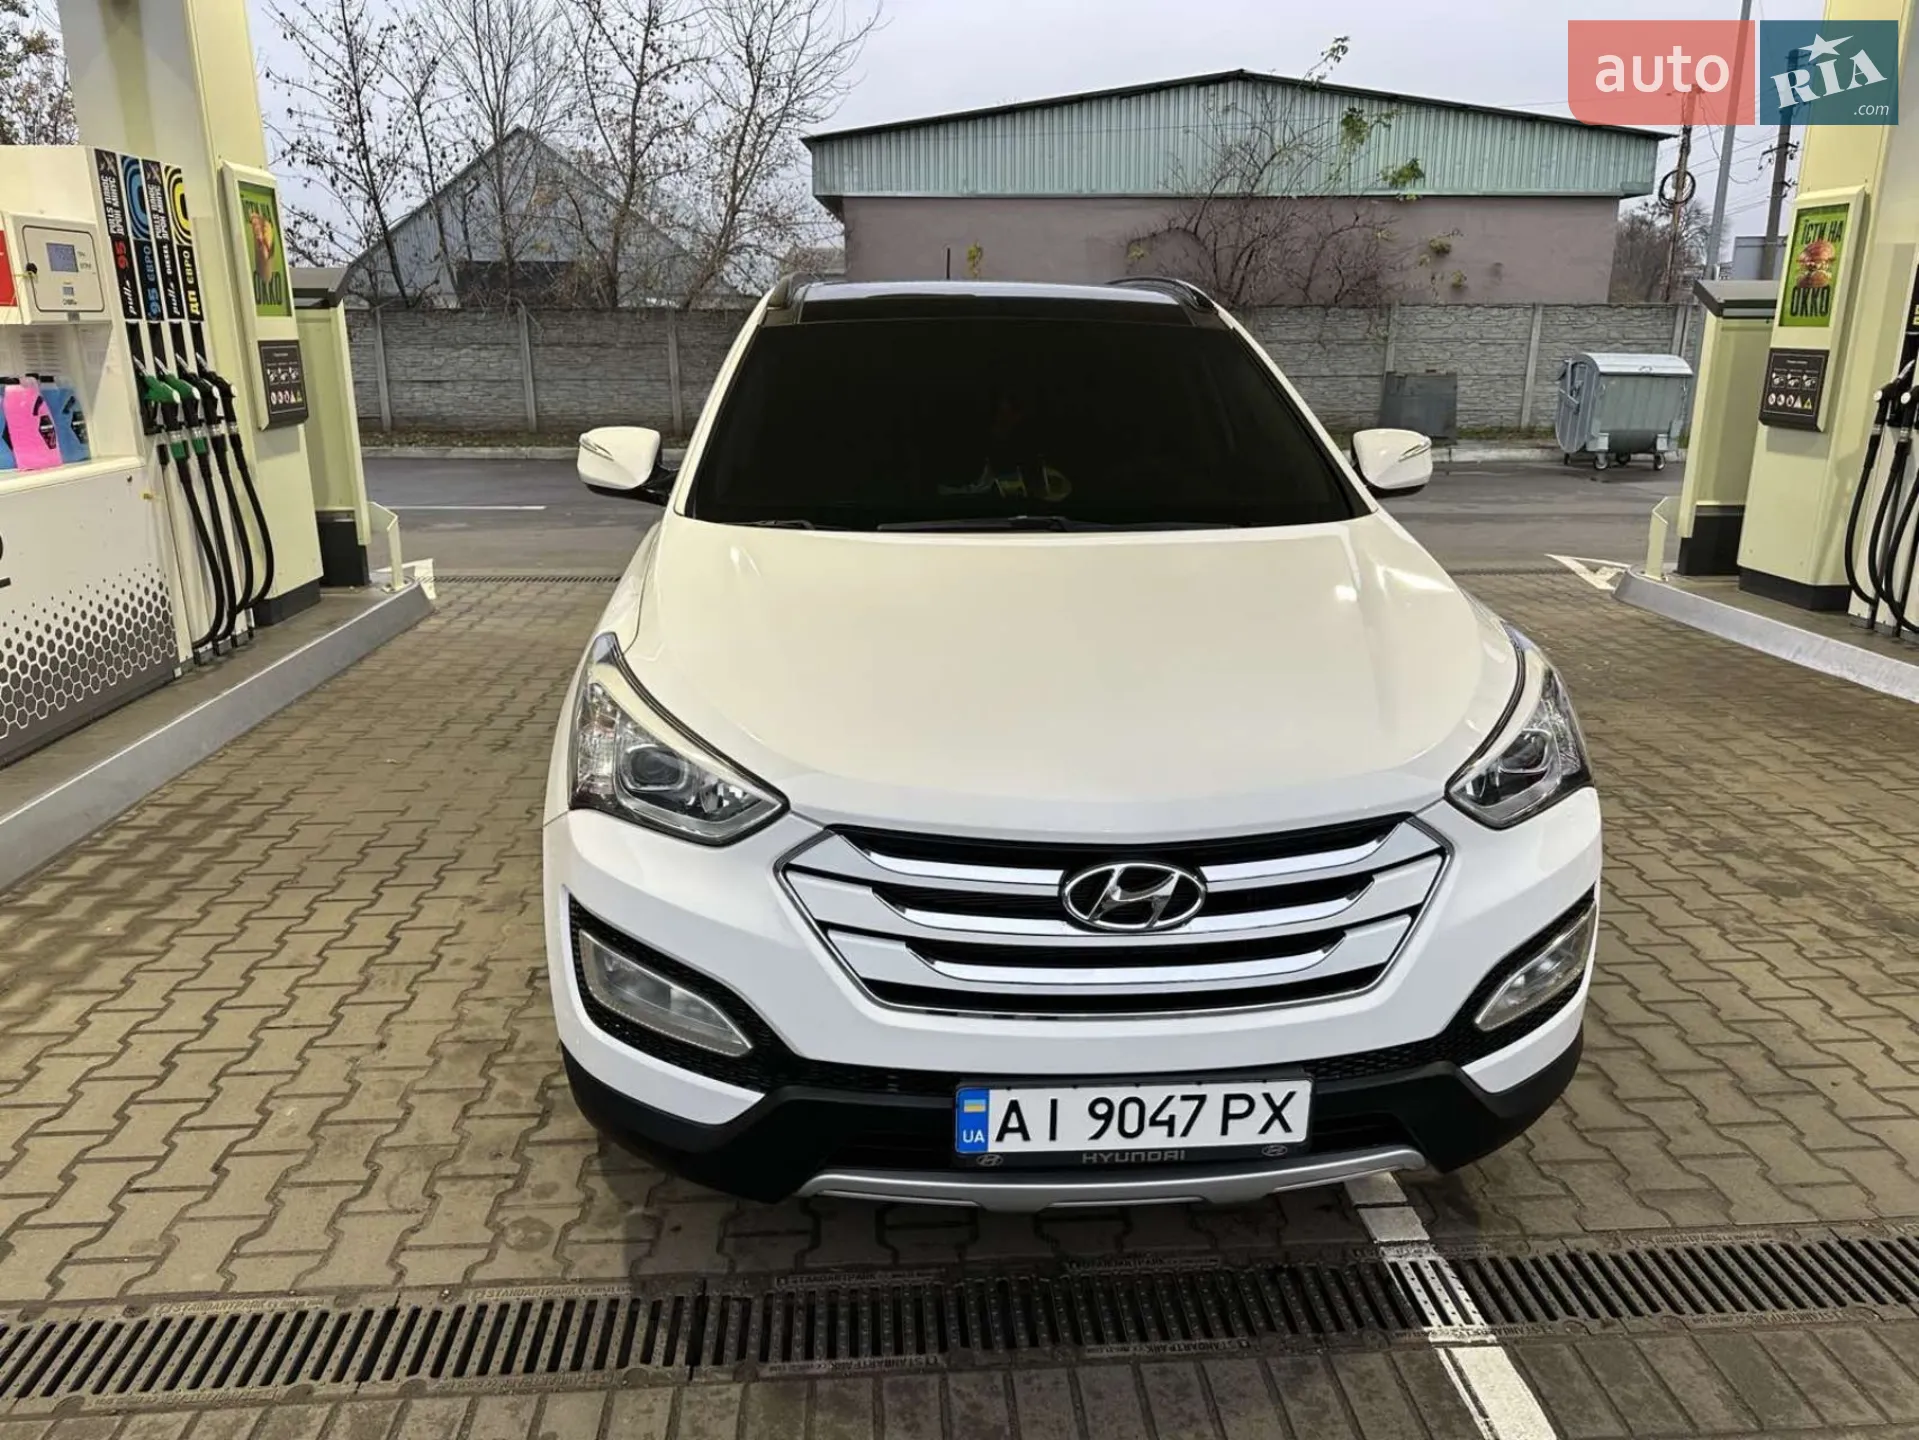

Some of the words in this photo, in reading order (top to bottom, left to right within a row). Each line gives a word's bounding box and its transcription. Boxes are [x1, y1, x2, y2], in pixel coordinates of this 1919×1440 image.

[115, 240, 129, 270] 95
[147, 287, 161, 318] 95
[187, 290, 201, 316] ДП
[1088, 1094, 1207, 1140] 9047
[1220, 1090, 1297, 1136] PX
[963, 1129, 985, 1144] UA
[1082, 1149, 1186, 1164] HYUNDAI
